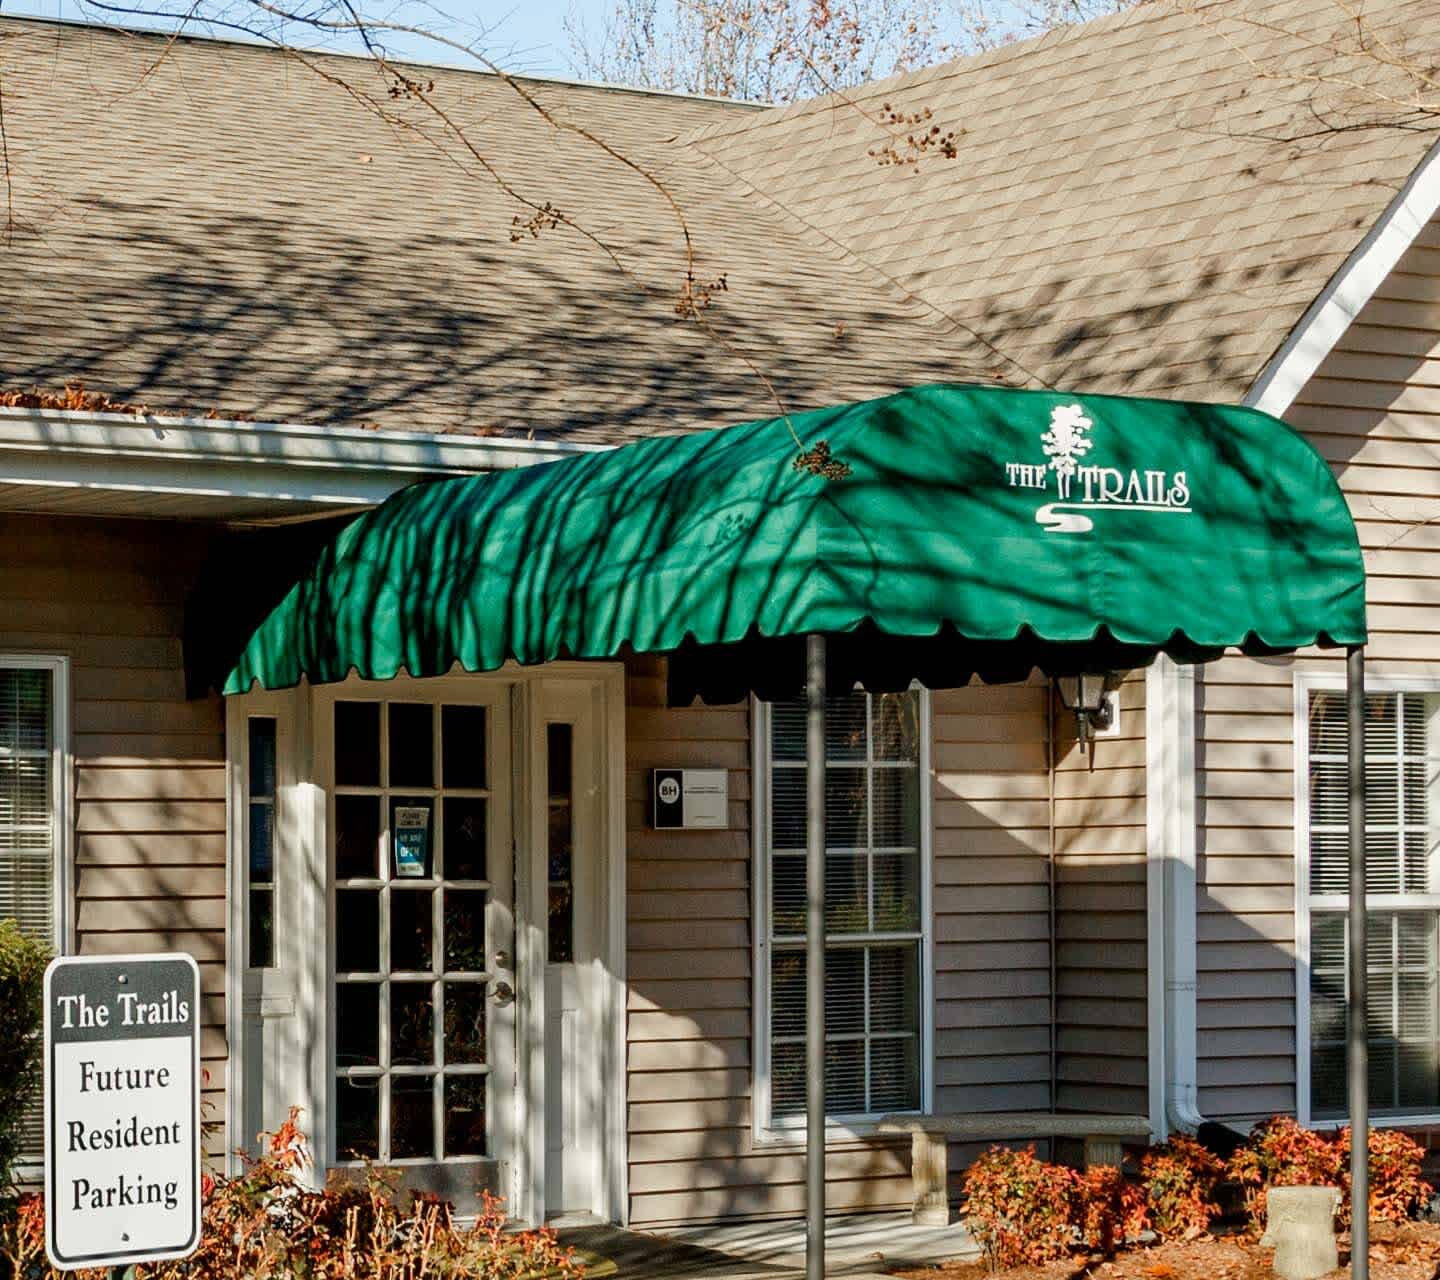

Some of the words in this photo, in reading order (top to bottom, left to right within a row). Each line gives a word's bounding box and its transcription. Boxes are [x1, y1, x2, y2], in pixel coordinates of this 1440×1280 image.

[1006, 462, 1047, 490] THE
[1077, 465, 1191, 506] TRAILS
[57, 994, 109, 1029] The
[117, 989, 189, 1026] Trails
[79, 1061, 170, 1093] Future
[67, 1115, 181, 1152] Resident
[72, 1175, 178, 1211] Parking
